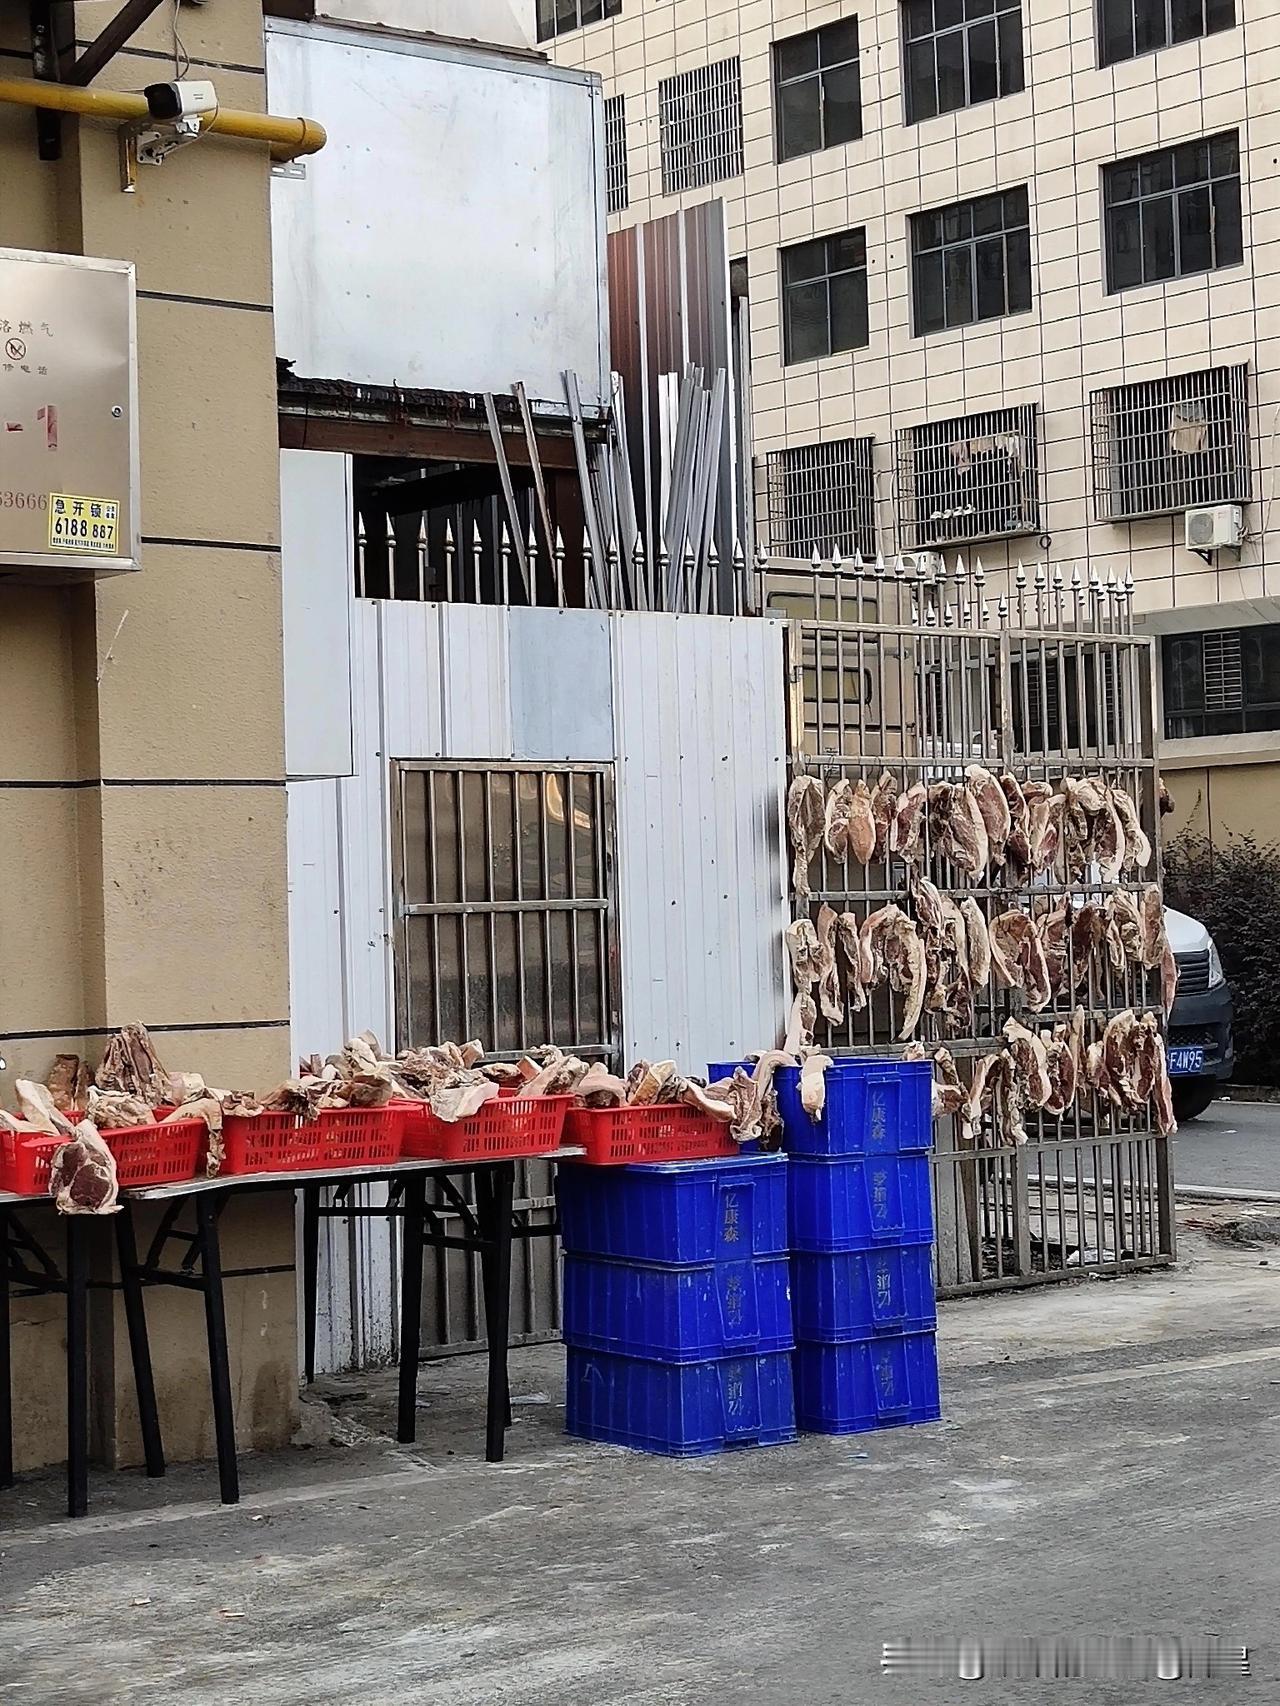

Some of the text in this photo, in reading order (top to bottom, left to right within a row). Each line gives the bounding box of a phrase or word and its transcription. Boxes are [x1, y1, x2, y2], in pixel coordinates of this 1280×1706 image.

[0, 491, 48, 511] 3666
[54, 499, 102, 518] 急开锁
[55, 517, 114, 540] 6188 887
[871, 1090, 886, 1140] 亿康森
[724, 1193, 739, 1242] 亿康森
